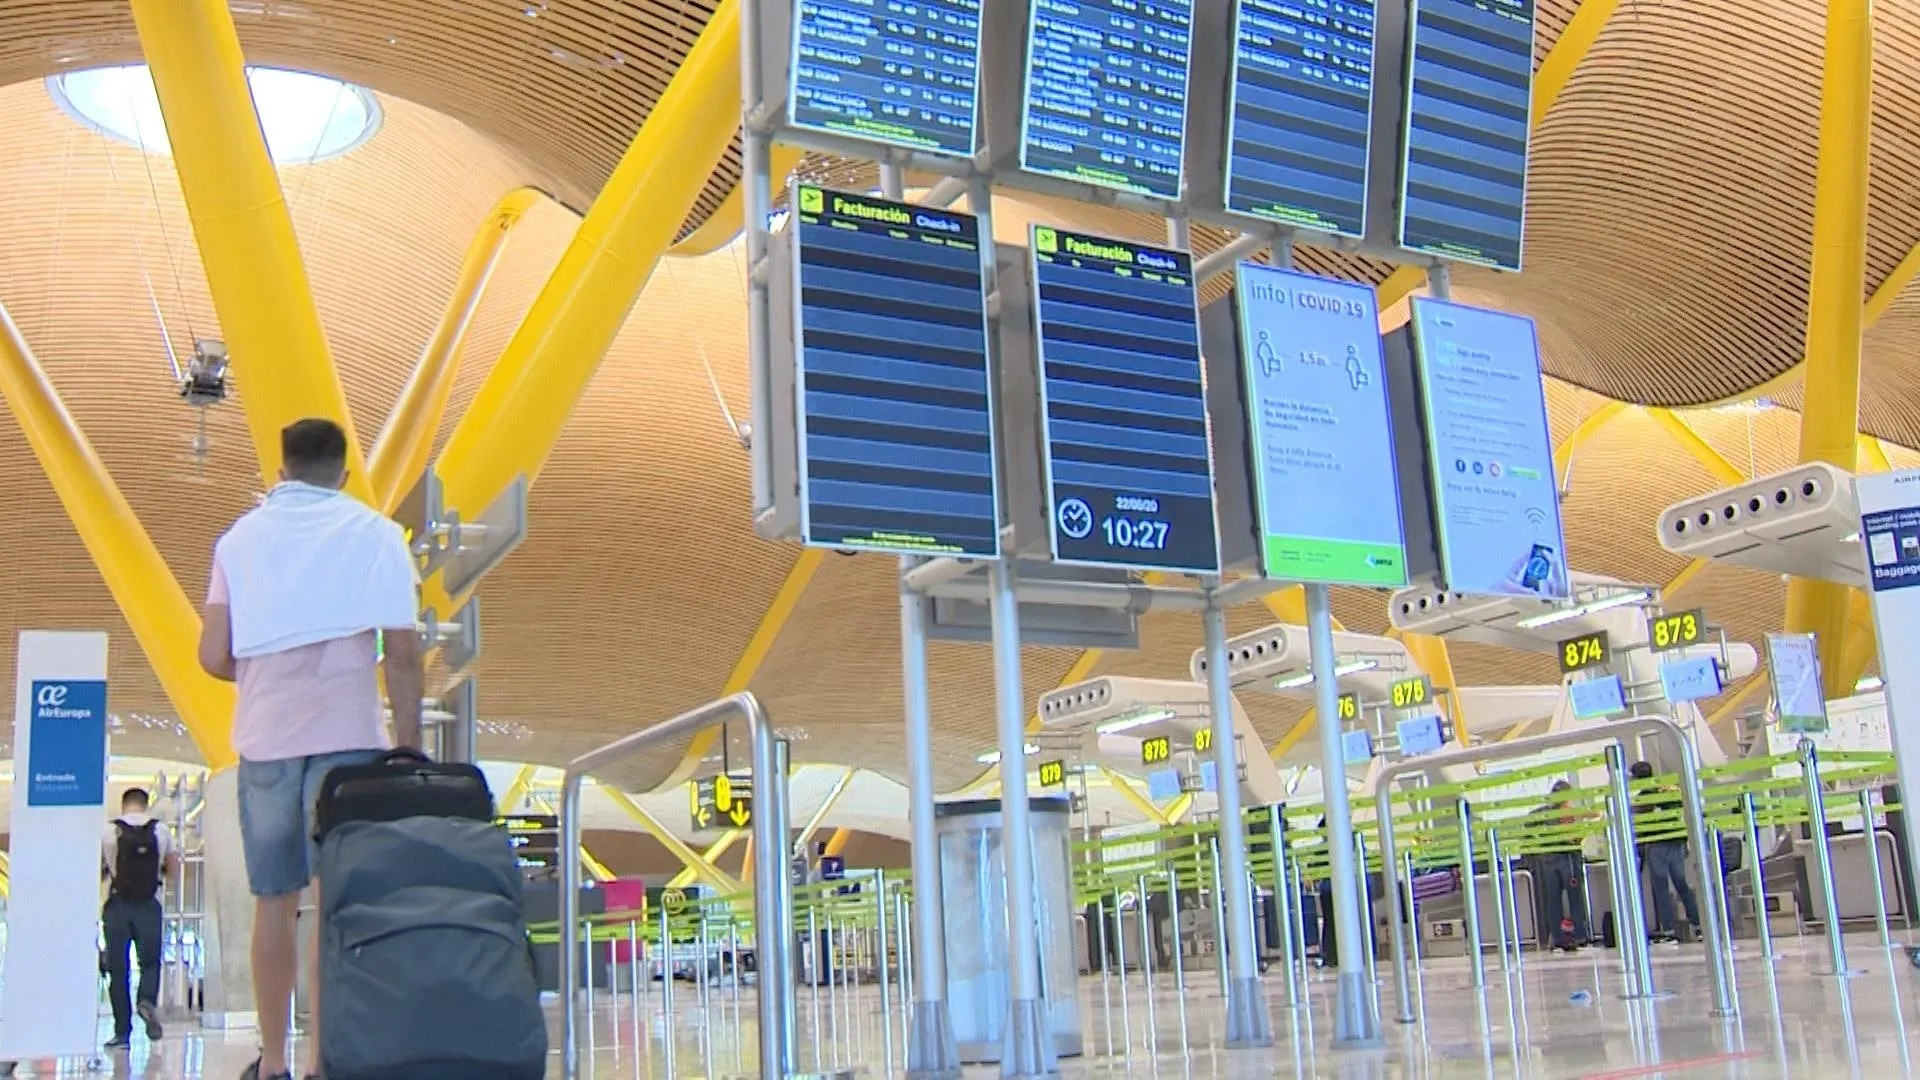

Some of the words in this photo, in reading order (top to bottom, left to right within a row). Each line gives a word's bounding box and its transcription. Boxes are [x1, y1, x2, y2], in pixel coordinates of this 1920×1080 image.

[833, 197, 911, 224] Facturación
[915, 214, 961, 232] Check-in
[1065, 236, 1133, 262] Facturación
[1136, 251, 1177, 269] Check-in
[1251, 280, 1285, 303] info
[1298, 292, 1364, 318] COVID-19
[1102, 516, 1170, 549] 10:27
[1655, 614, 1697, 647] 873
[1565, 637, 1603, 667] 874
[1337, 695, 1355, 718] 76
[1144, 738, 1168, 762] 878
[1195, 728, 1211, 751] 87
